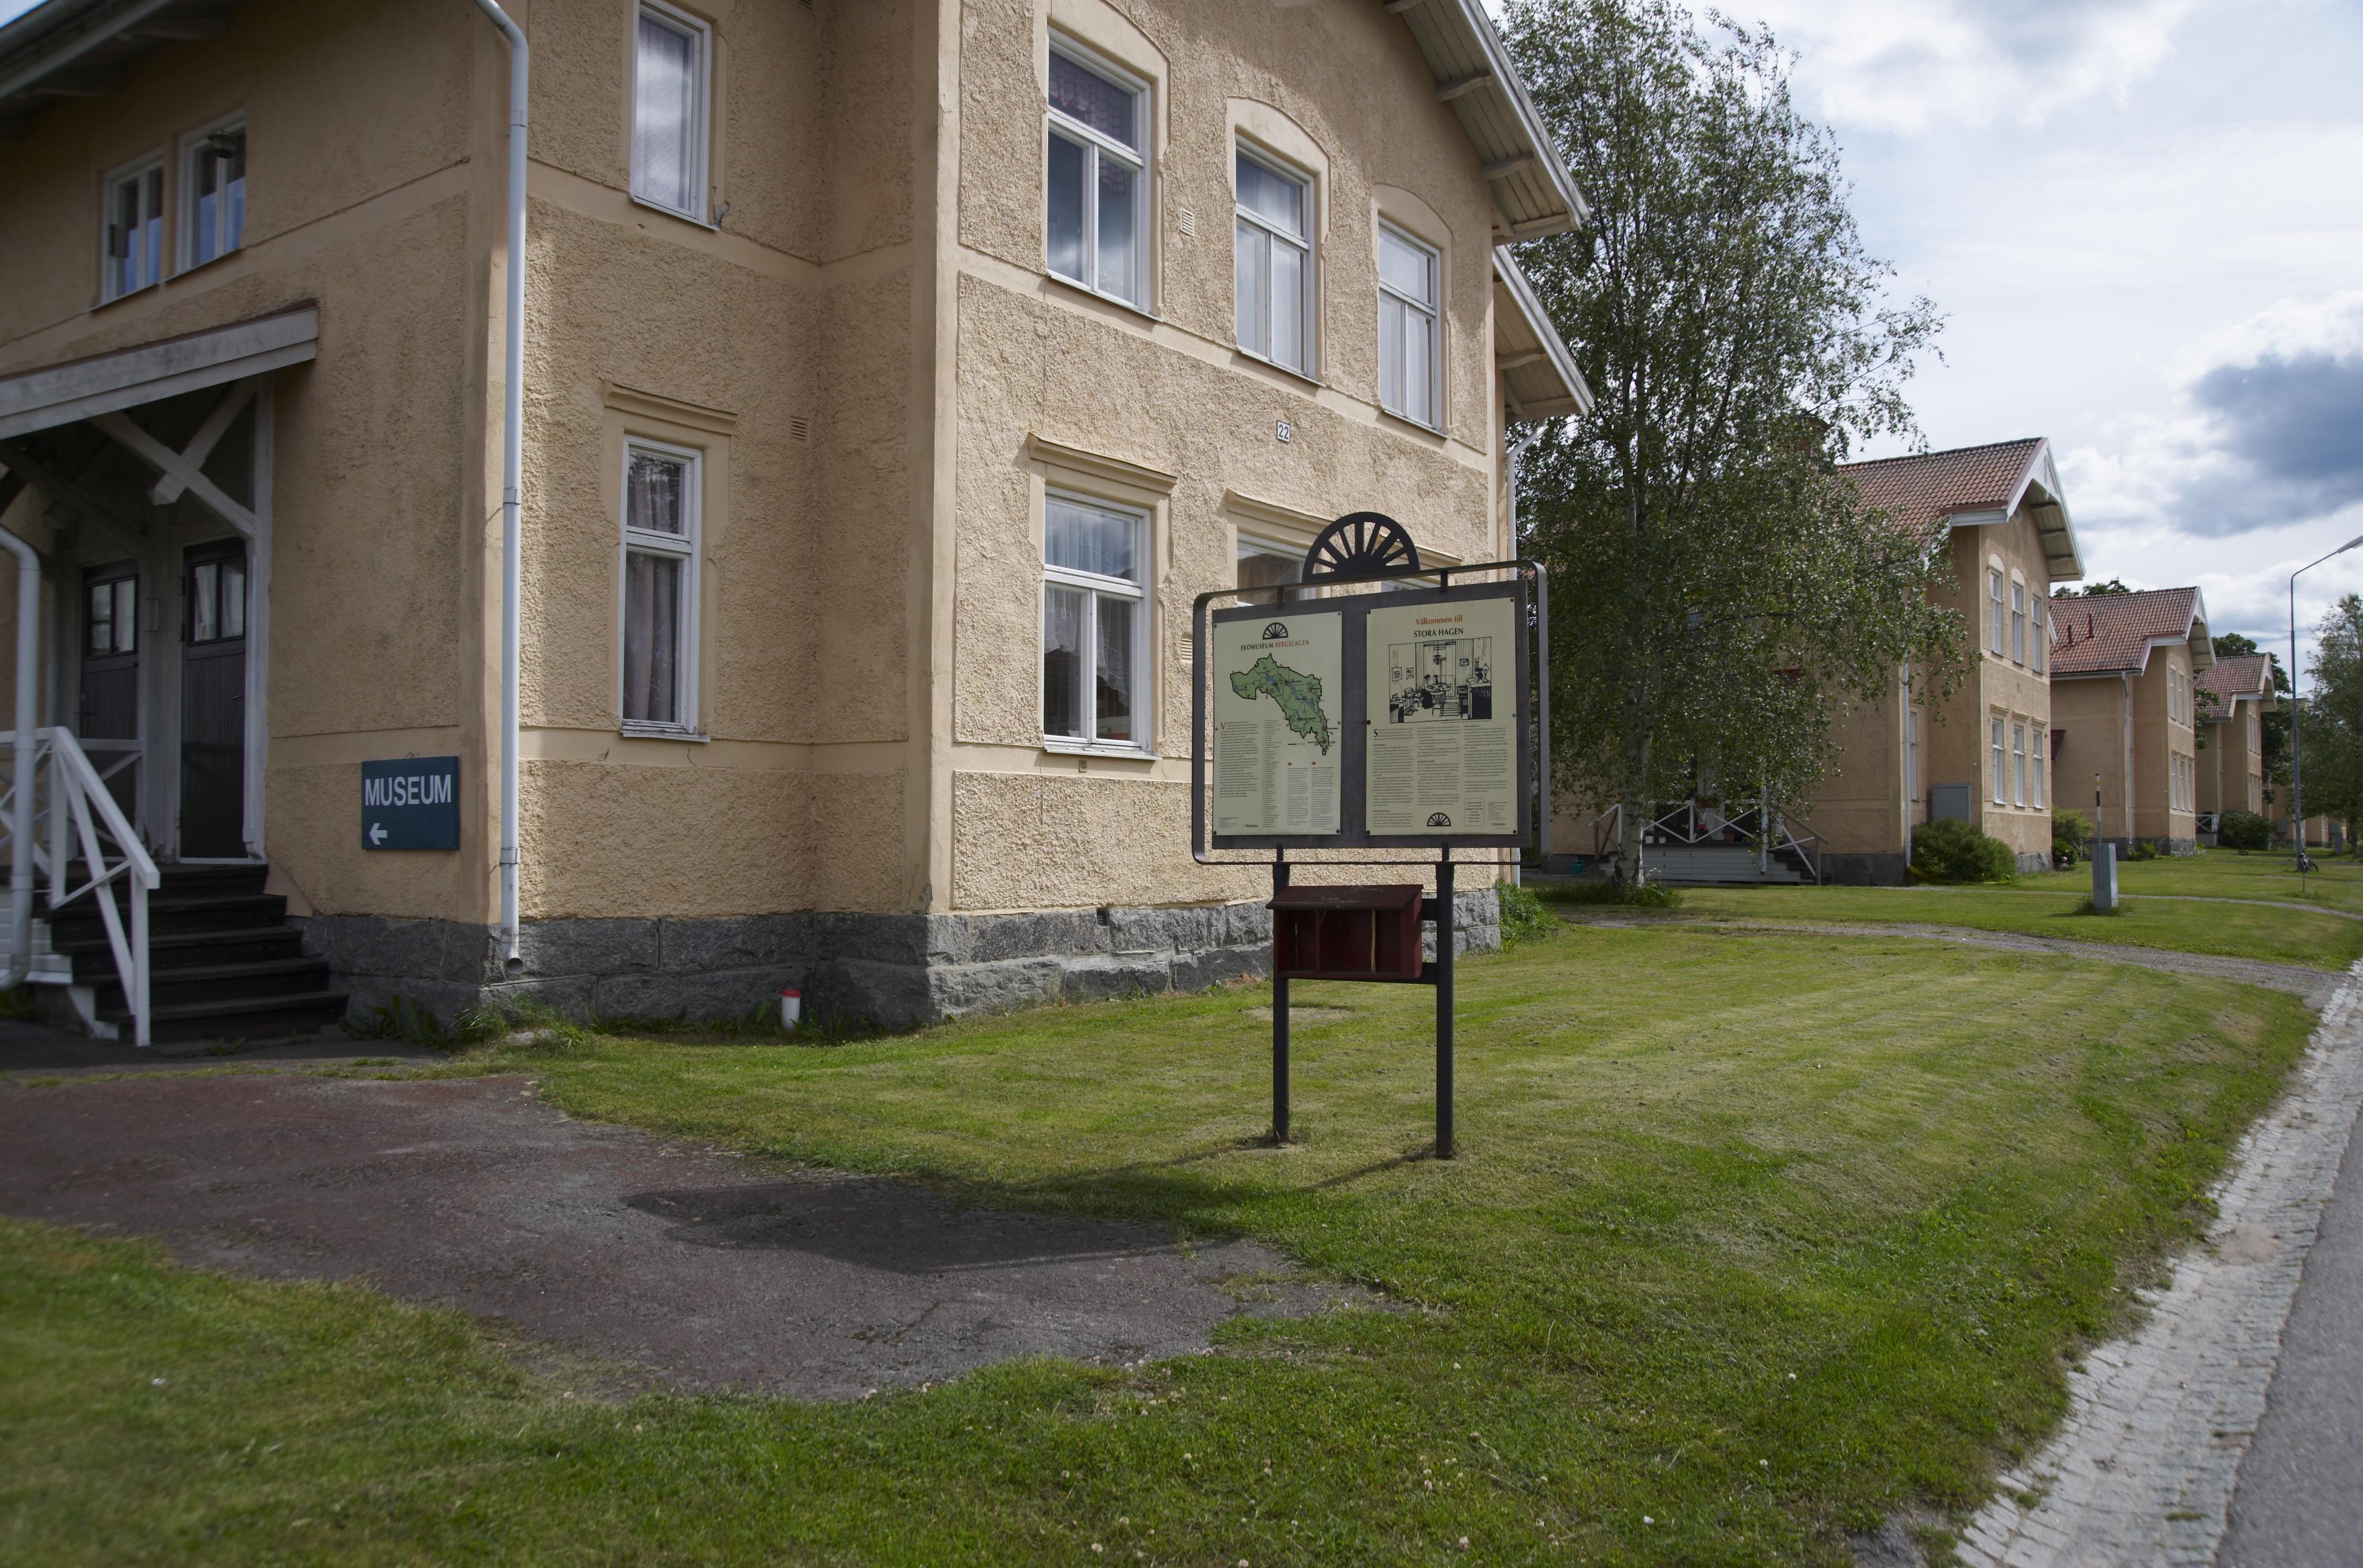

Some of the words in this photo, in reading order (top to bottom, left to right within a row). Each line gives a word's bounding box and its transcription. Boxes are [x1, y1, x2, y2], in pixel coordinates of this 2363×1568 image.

[1279, 424, 1289, 440] 22
[1439, 627, 1464, 636] HAGEN
[1275, 639, 1309, 647] BERGSLAGEN
[365, 774, 451, 806] MUSEUM
